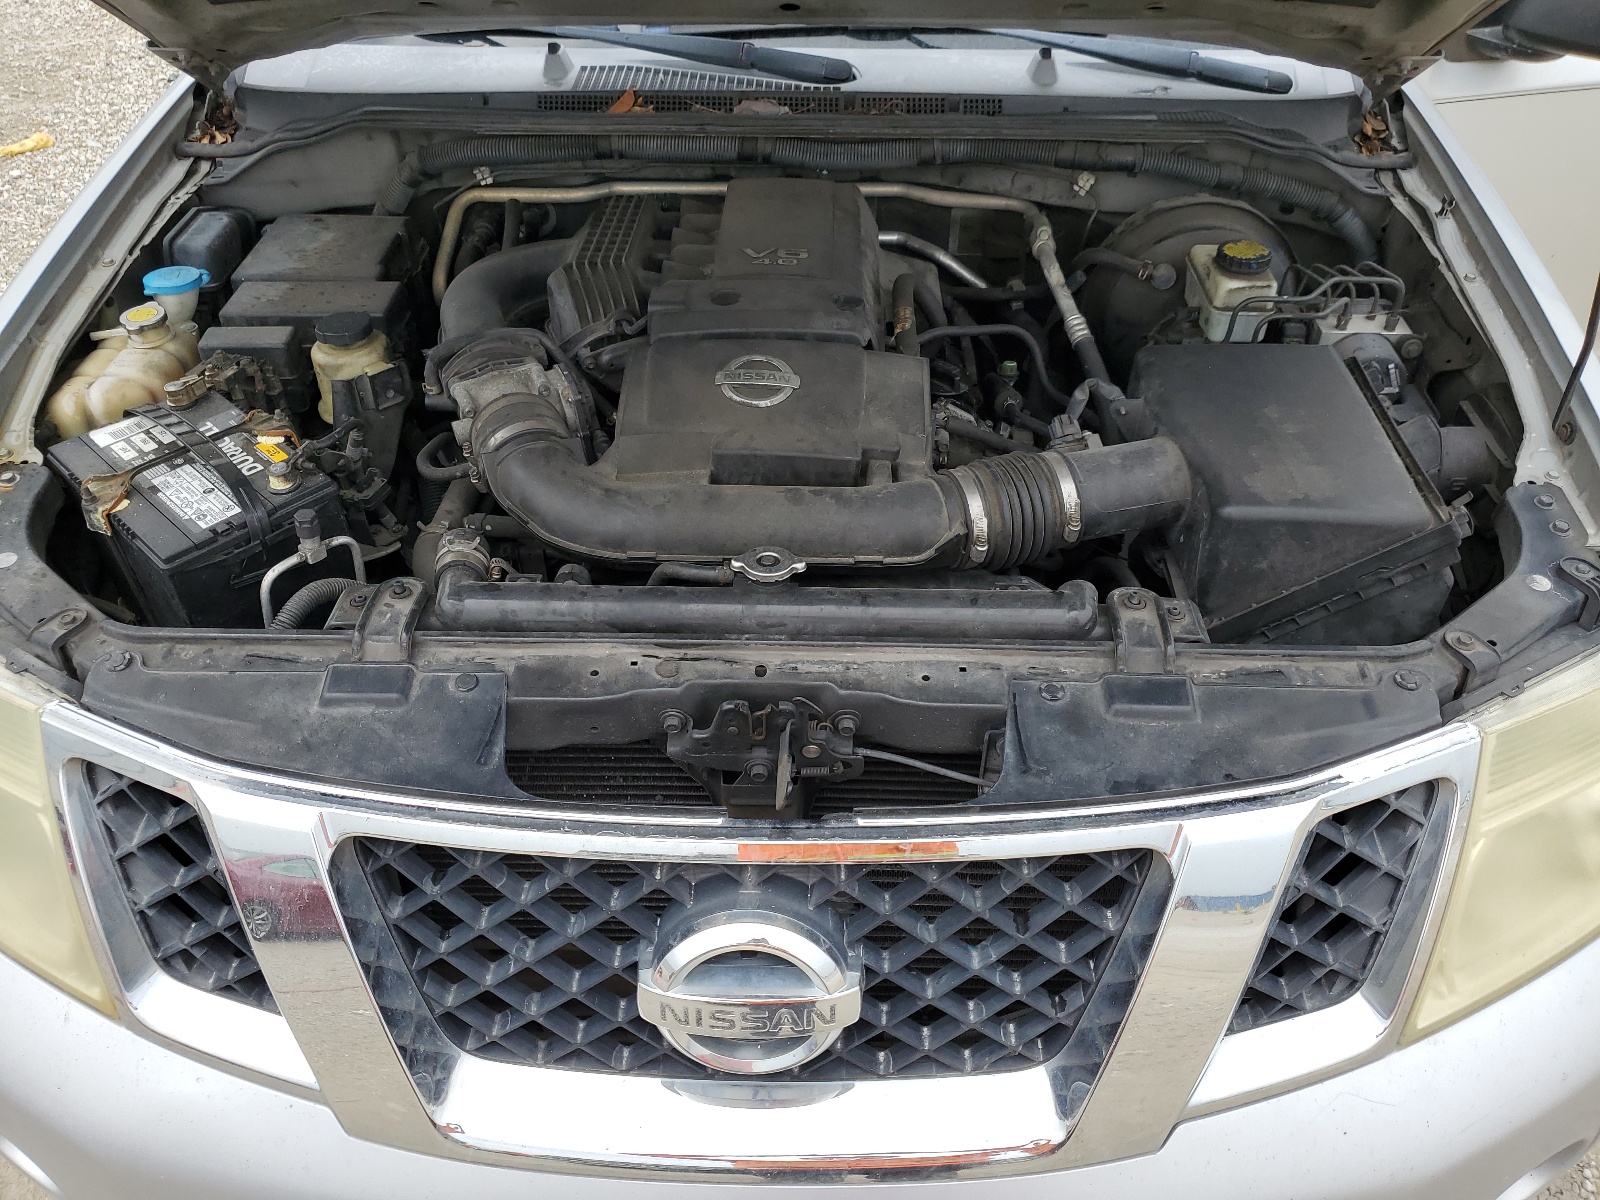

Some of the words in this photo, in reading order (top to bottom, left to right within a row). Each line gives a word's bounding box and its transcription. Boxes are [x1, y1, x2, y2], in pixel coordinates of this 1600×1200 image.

[741, 247, 809, 259] V6
[751, 258, 798, 266] 4.0
[723, 371, 791, 383] NISSAN
[198, 421, 265, 476] DURACLL
[660, 1002, 837, 1032] NISSAN
